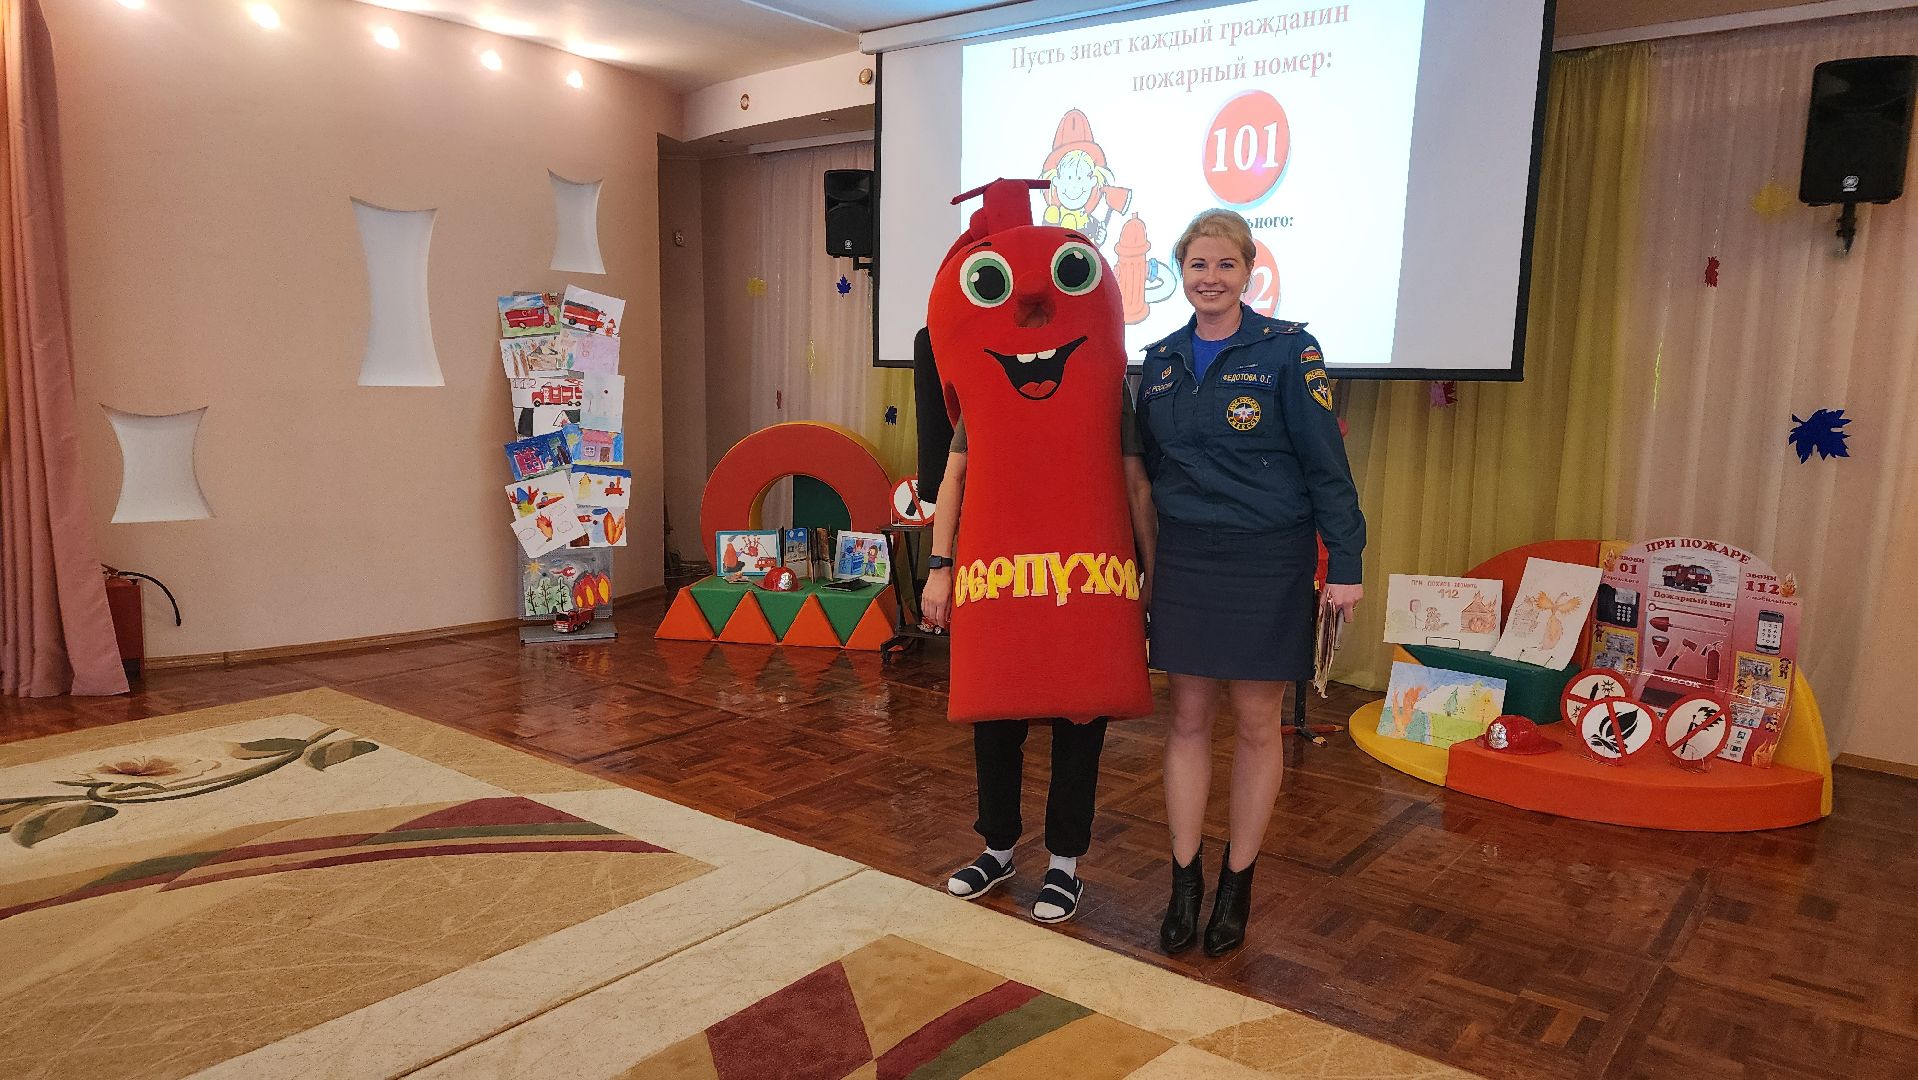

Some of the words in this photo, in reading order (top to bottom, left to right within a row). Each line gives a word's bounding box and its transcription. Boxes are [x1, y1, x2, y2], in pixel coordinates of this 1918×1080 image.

[1011, 46, 1065, 74] Пусть
[1070, 38, 1121, 61] знает
[1128, 19, 1213, 53] каждый
[1219, 5, 1350, 47] гражданин
[1133, 56, 1248, 93] пожарный
[1252, 51, 1332, 78] номер:
[1212, 121, 1279, 173] 101
[1247, 216, 1294, 229] ьного:
[512, 378, 537, 390] 112
[1222, 373, 1258, 383] ФЕДОТОВА
[1645, 539, 1676, 553] ПРИ
[1680, 538, 1751, 565] ПОЖАРЕ
[1619, 562, 1638, 575] 01
[1438, 588, 1460, 599] 112
[1744, 580, 1780, 596] 112
[1653, 590, 1708, 605] Пожарный
[1710, 600, 1732, 609] щит
